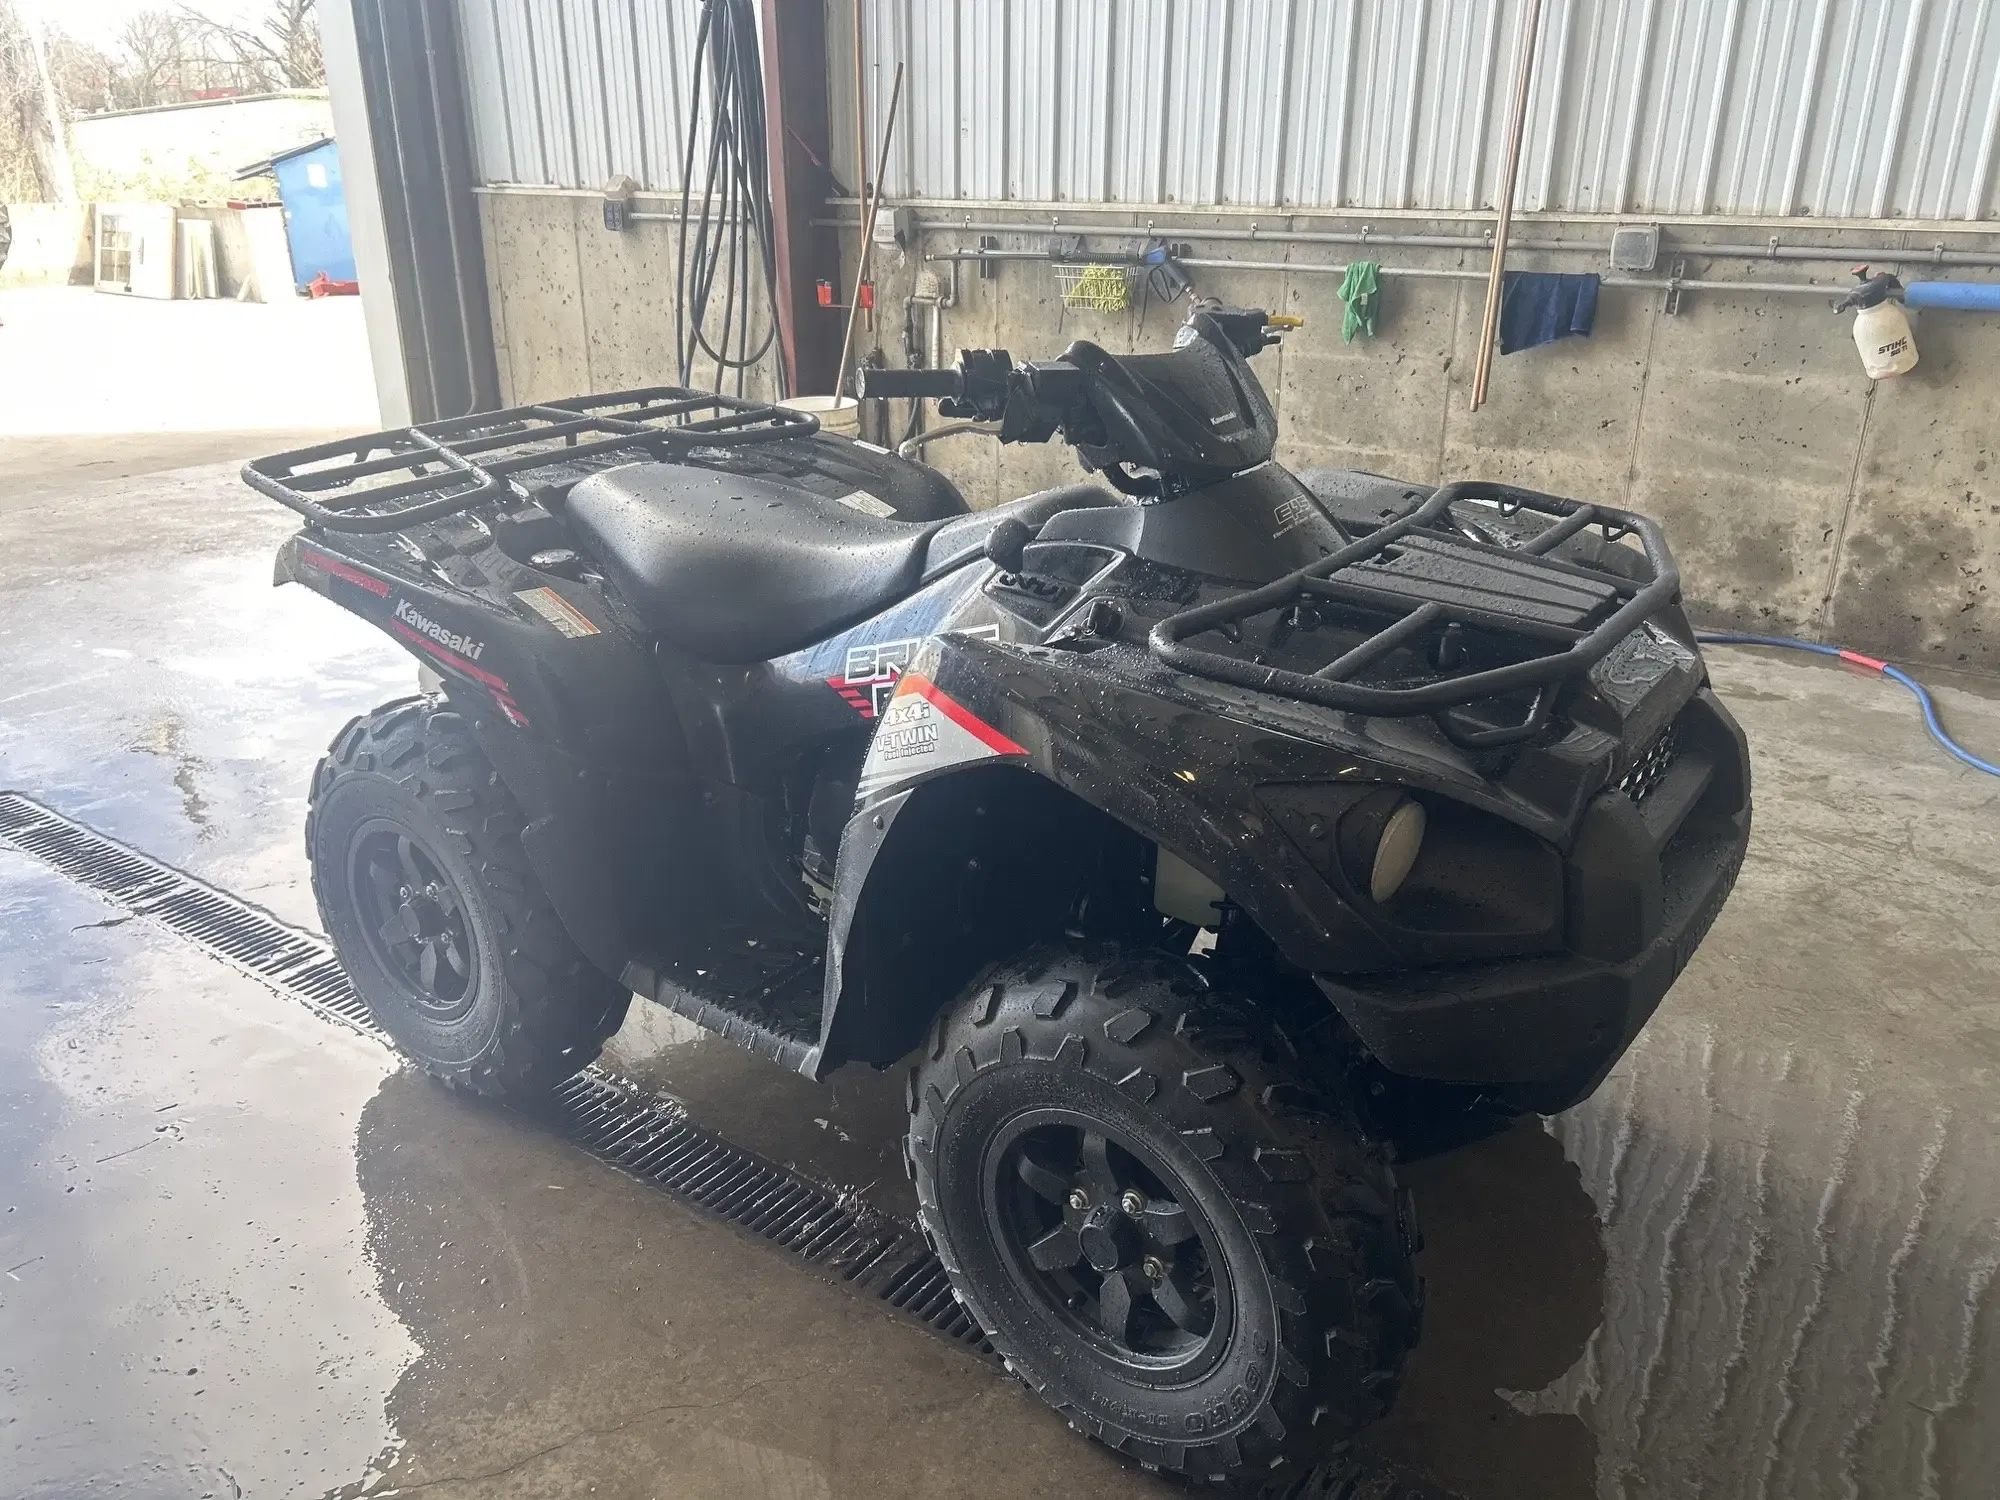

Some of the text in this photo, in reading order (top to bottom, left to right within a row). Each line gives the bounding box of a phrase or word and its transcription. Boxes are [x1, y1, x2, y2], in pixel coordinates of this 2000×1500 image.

[1878, 336, 1907, 354] STIHL
[1273, 494, 1311, 525] EPS
[394, 598, 485, 661] Kawasaki
[884, 701, 930, 726] 4x4i
[875, 723, 939, 752] V-TWIN
[900, 743, 935, 758] Injected
